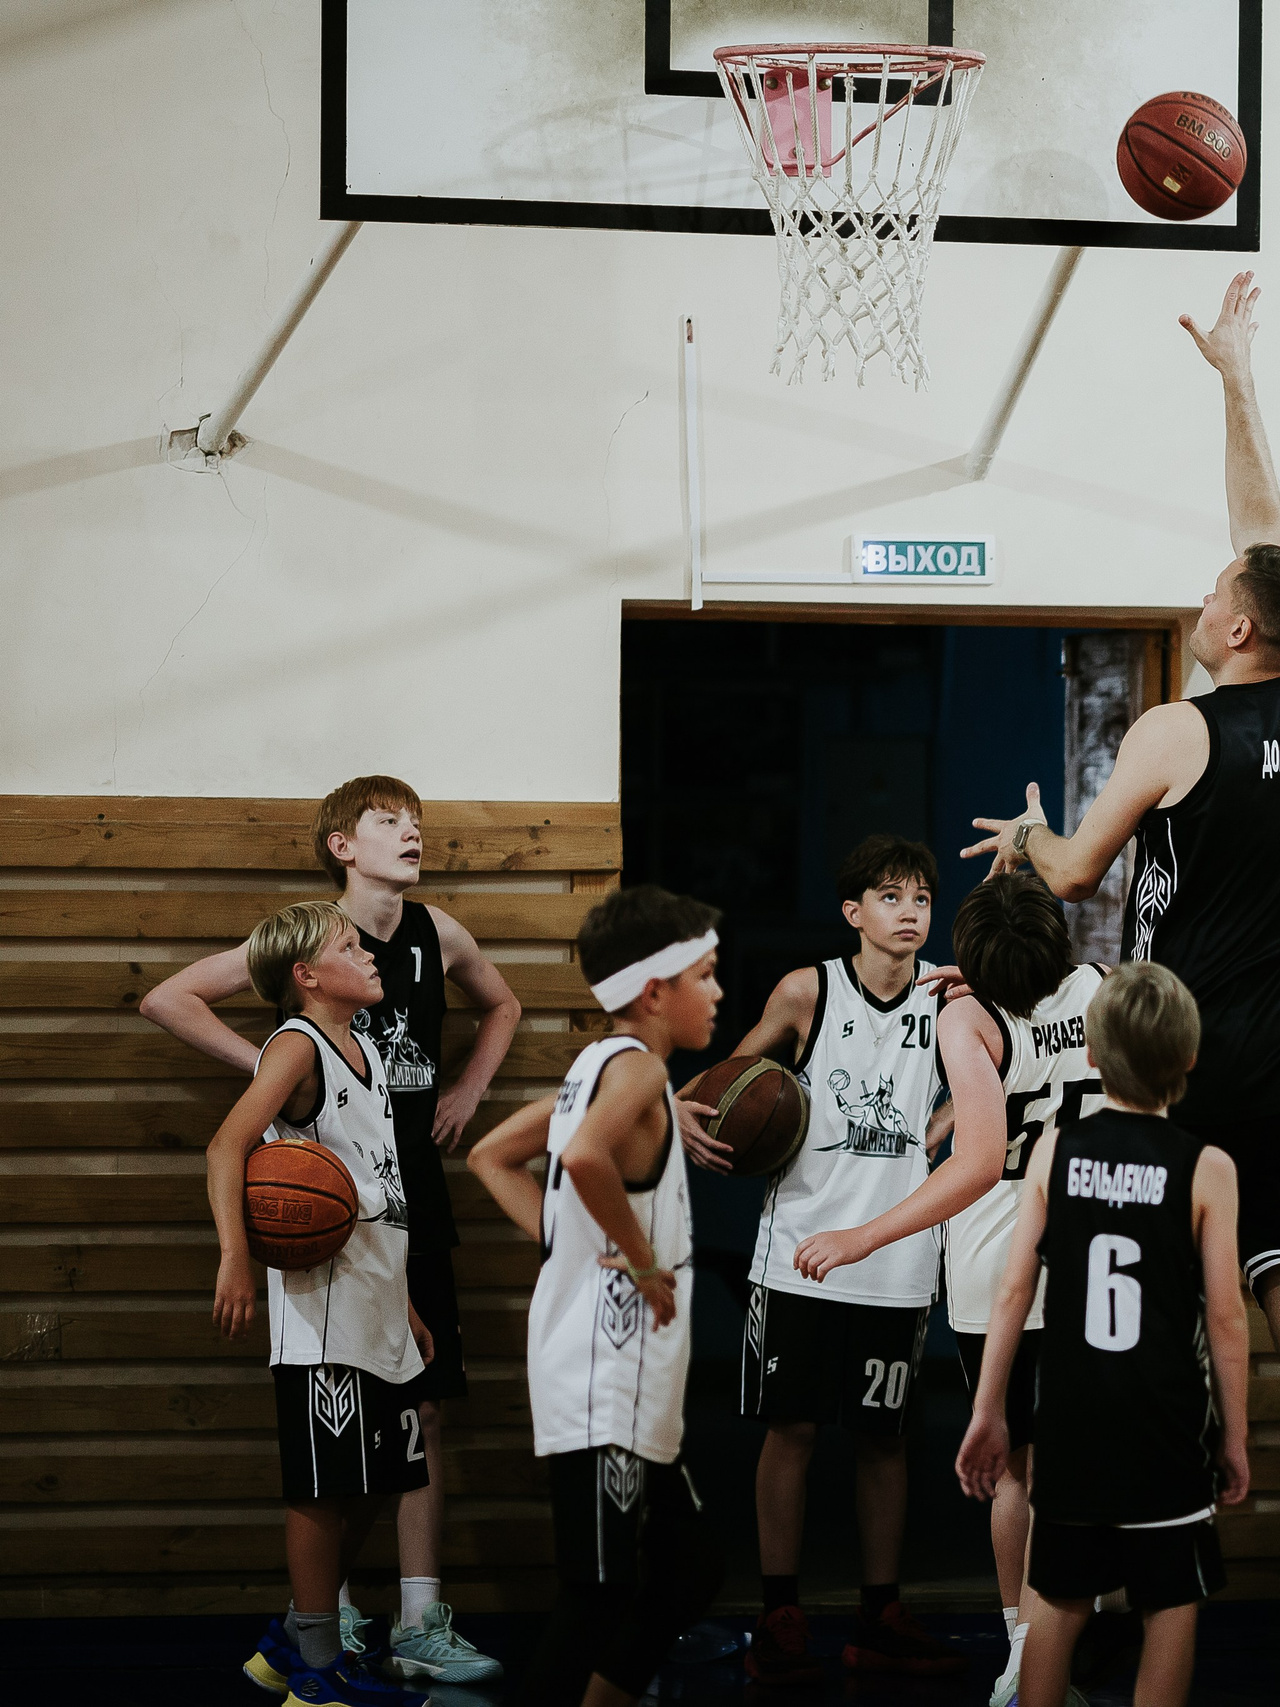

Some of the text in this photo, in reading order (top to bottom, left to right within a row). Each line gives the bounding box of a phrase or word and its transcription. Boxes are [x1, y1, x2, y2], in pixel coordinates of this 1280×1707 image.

[1176, 113, 1204, 136] BM
[1204, 130, 1231, 160] 900
[867, 544, 981, 575] ВЫХОД
[901, 1013, 931, 1050] 20
[1031, 1015, 1086, 1059] РИЗАЕВ
[383, 1059, 432, 1086] OLMATON
[378, 1083, 392, 1119] 2
[1084, 1233, 1142, 1351] 6
[862, 1358, 909, 1410] 20
[400, 1408, 425, 1463] 2
